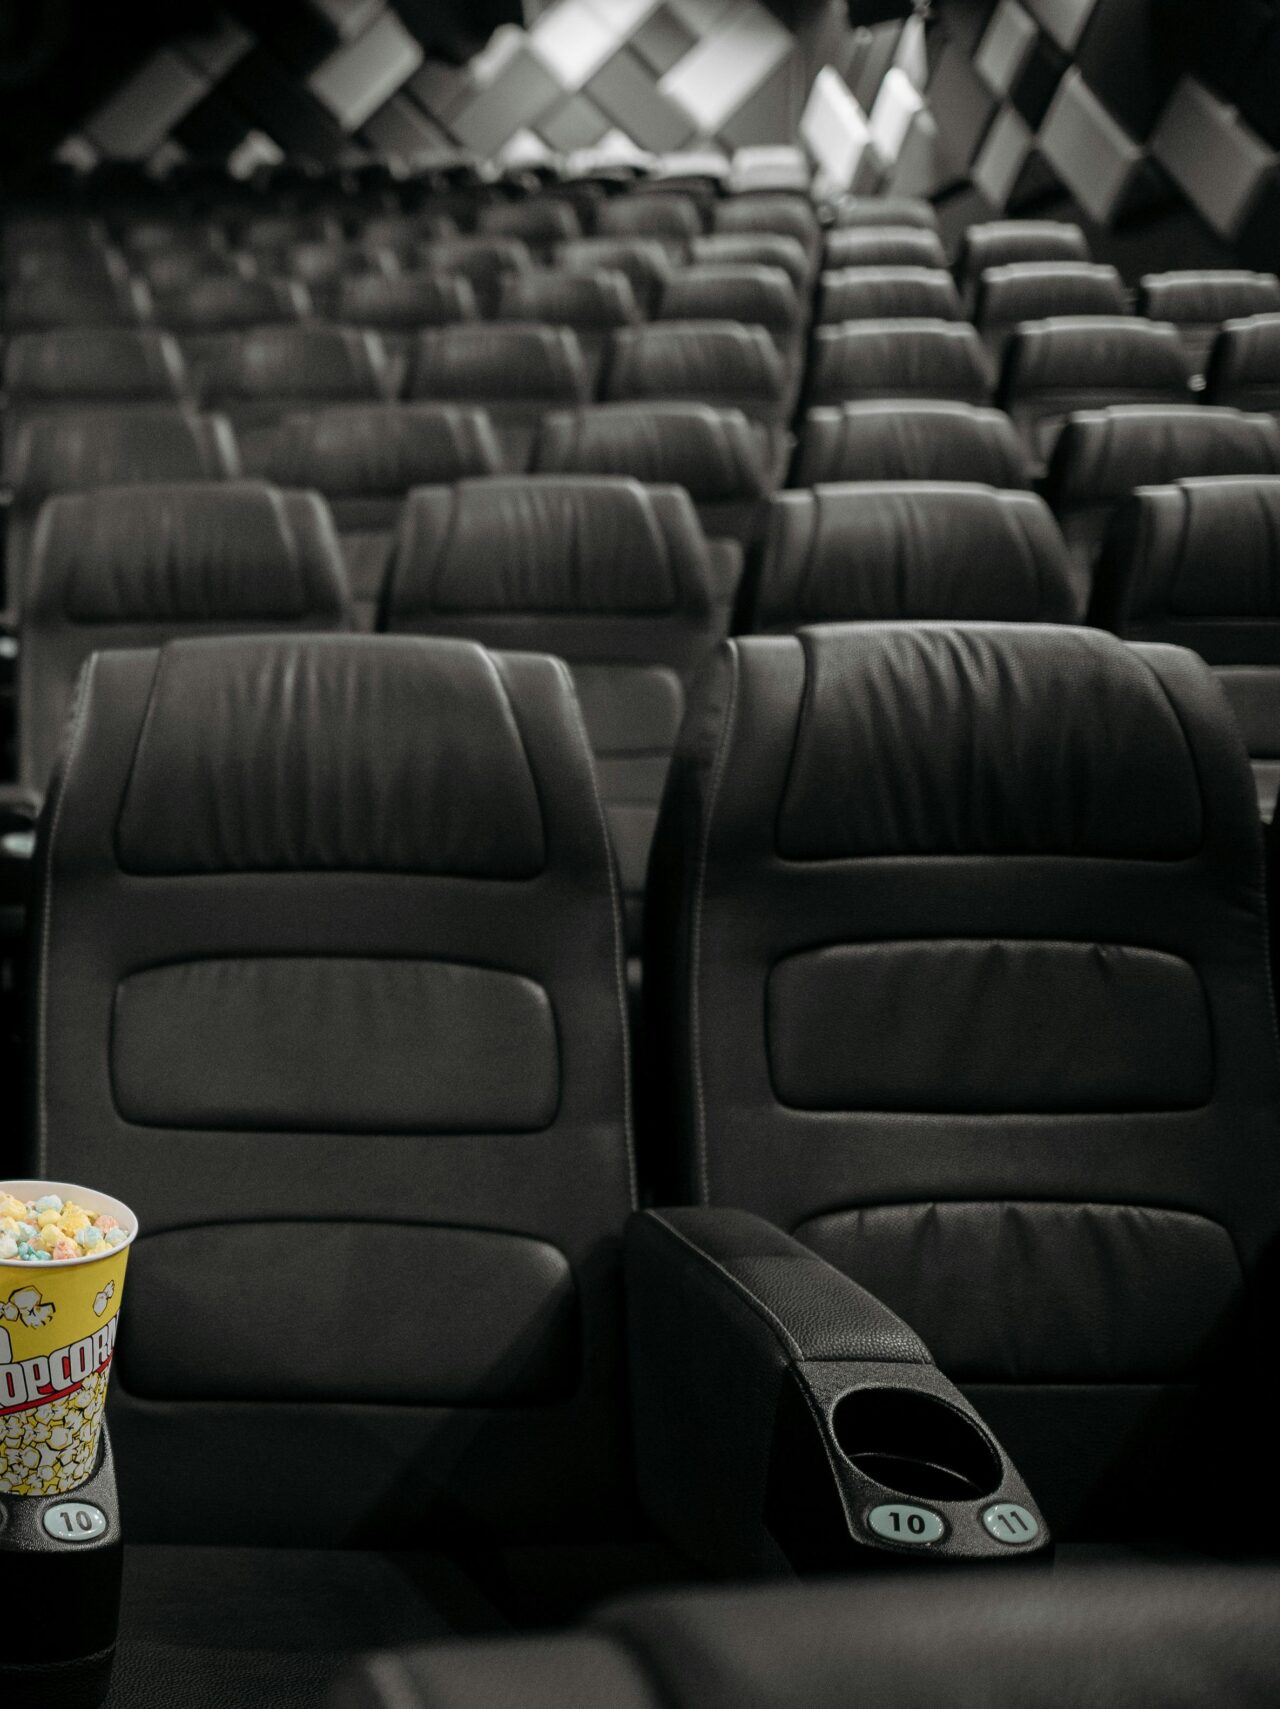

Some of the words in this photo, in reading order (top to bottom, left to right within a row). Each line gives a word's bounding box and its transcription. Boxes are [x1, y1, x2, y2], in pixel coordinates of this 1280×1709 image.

[59, 1510, 93, 1532] 10
[888, 1511, 926, 1535] 10
[997, 1510, 1029, 1535] 11
